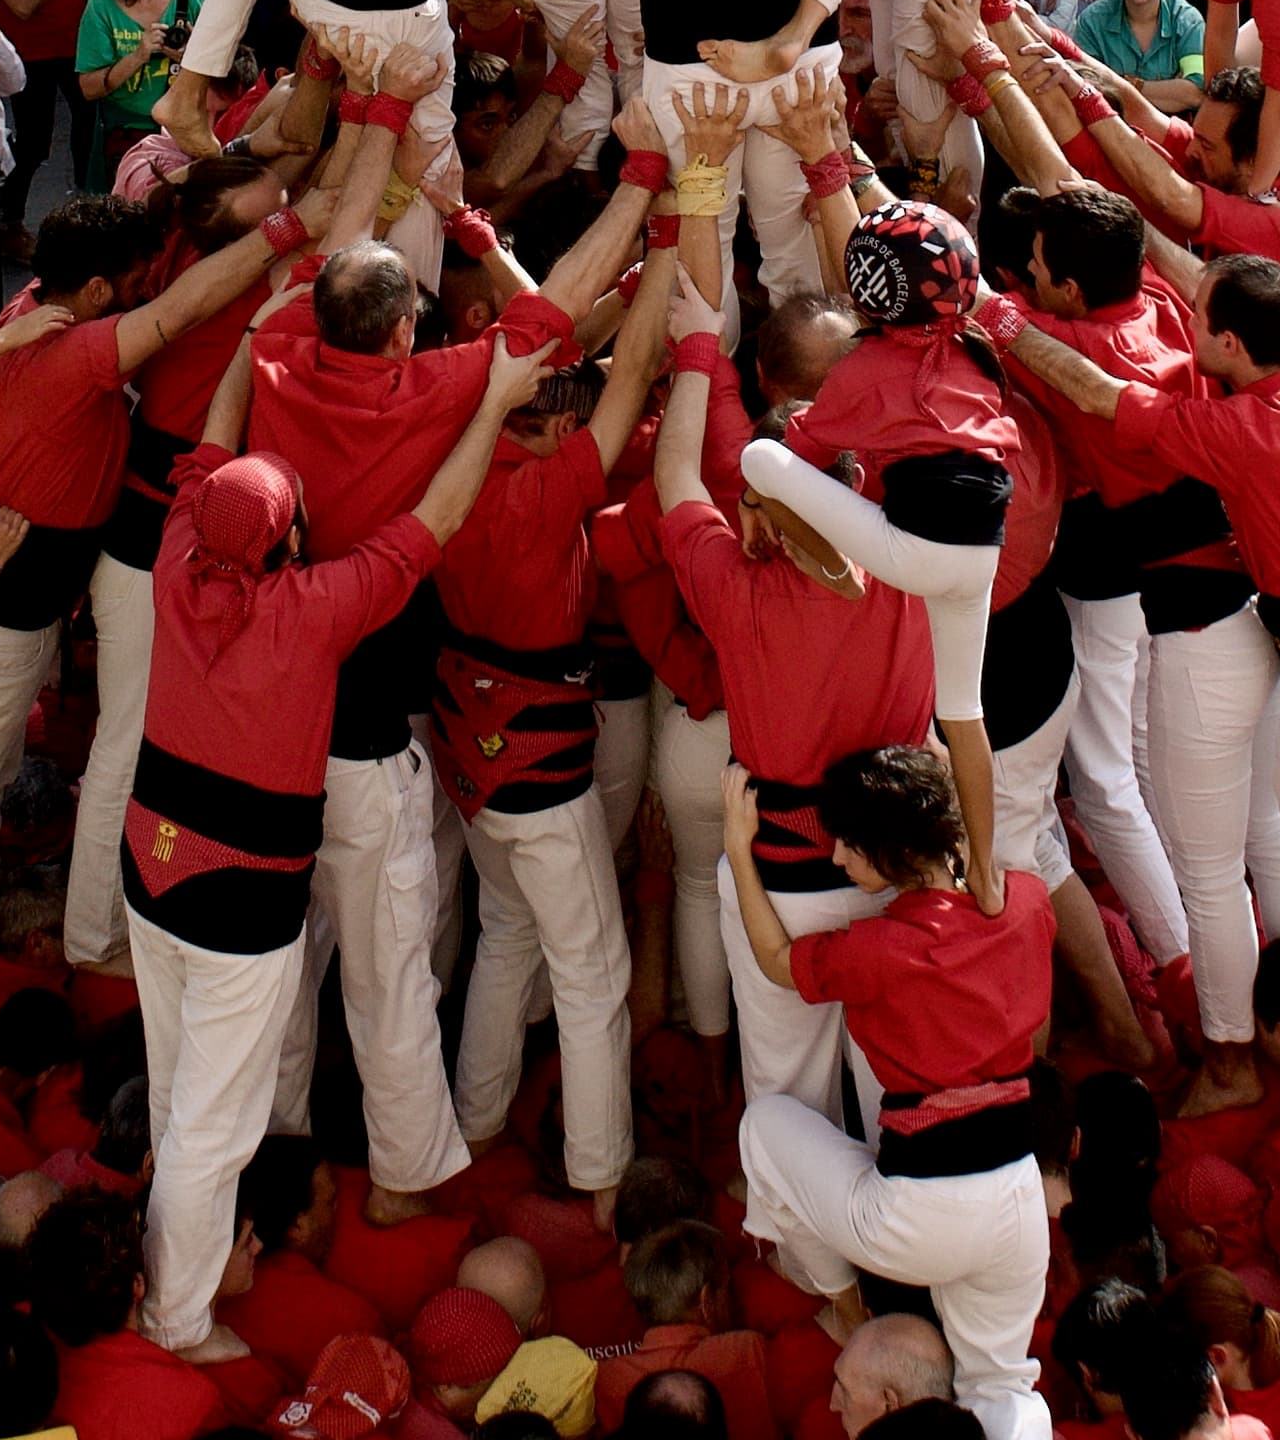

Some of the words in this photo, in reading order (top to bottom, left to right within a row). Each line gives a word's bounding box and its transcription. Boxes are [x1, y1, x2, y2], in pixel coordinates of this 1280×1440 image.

[878, 243, 894, 260] DE
[882, 257, 909, 322] BARCELONA
[584, 1339, 641, 1361] ascuts
